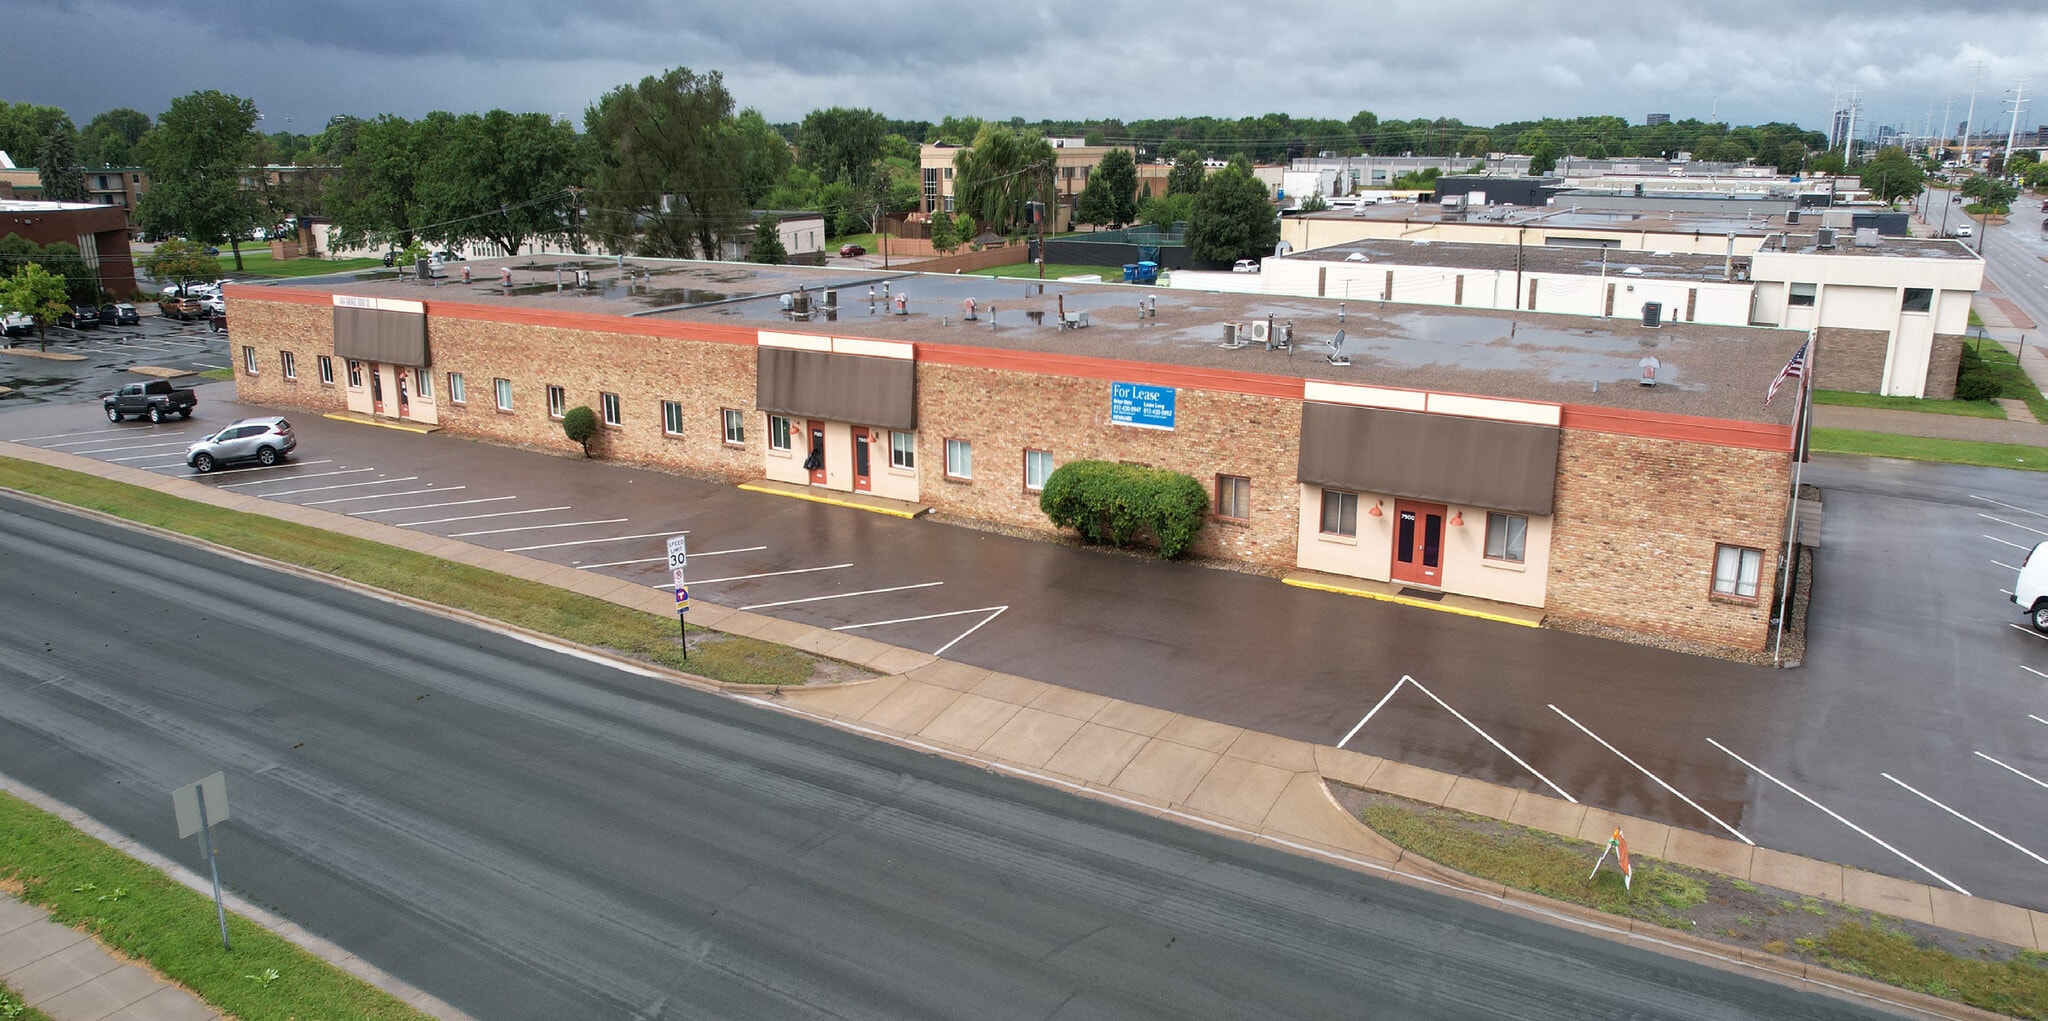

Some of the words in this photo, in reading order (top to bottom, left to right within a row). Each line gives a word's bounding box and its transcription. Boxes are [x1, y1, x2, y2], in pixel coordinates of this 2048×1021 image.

[1114, 384, 1130, 398] For
[1132, 386, 1160, 401] Lease
[669, 539, 684, 548] SPEED
[670, 553, 685, 566] 30
